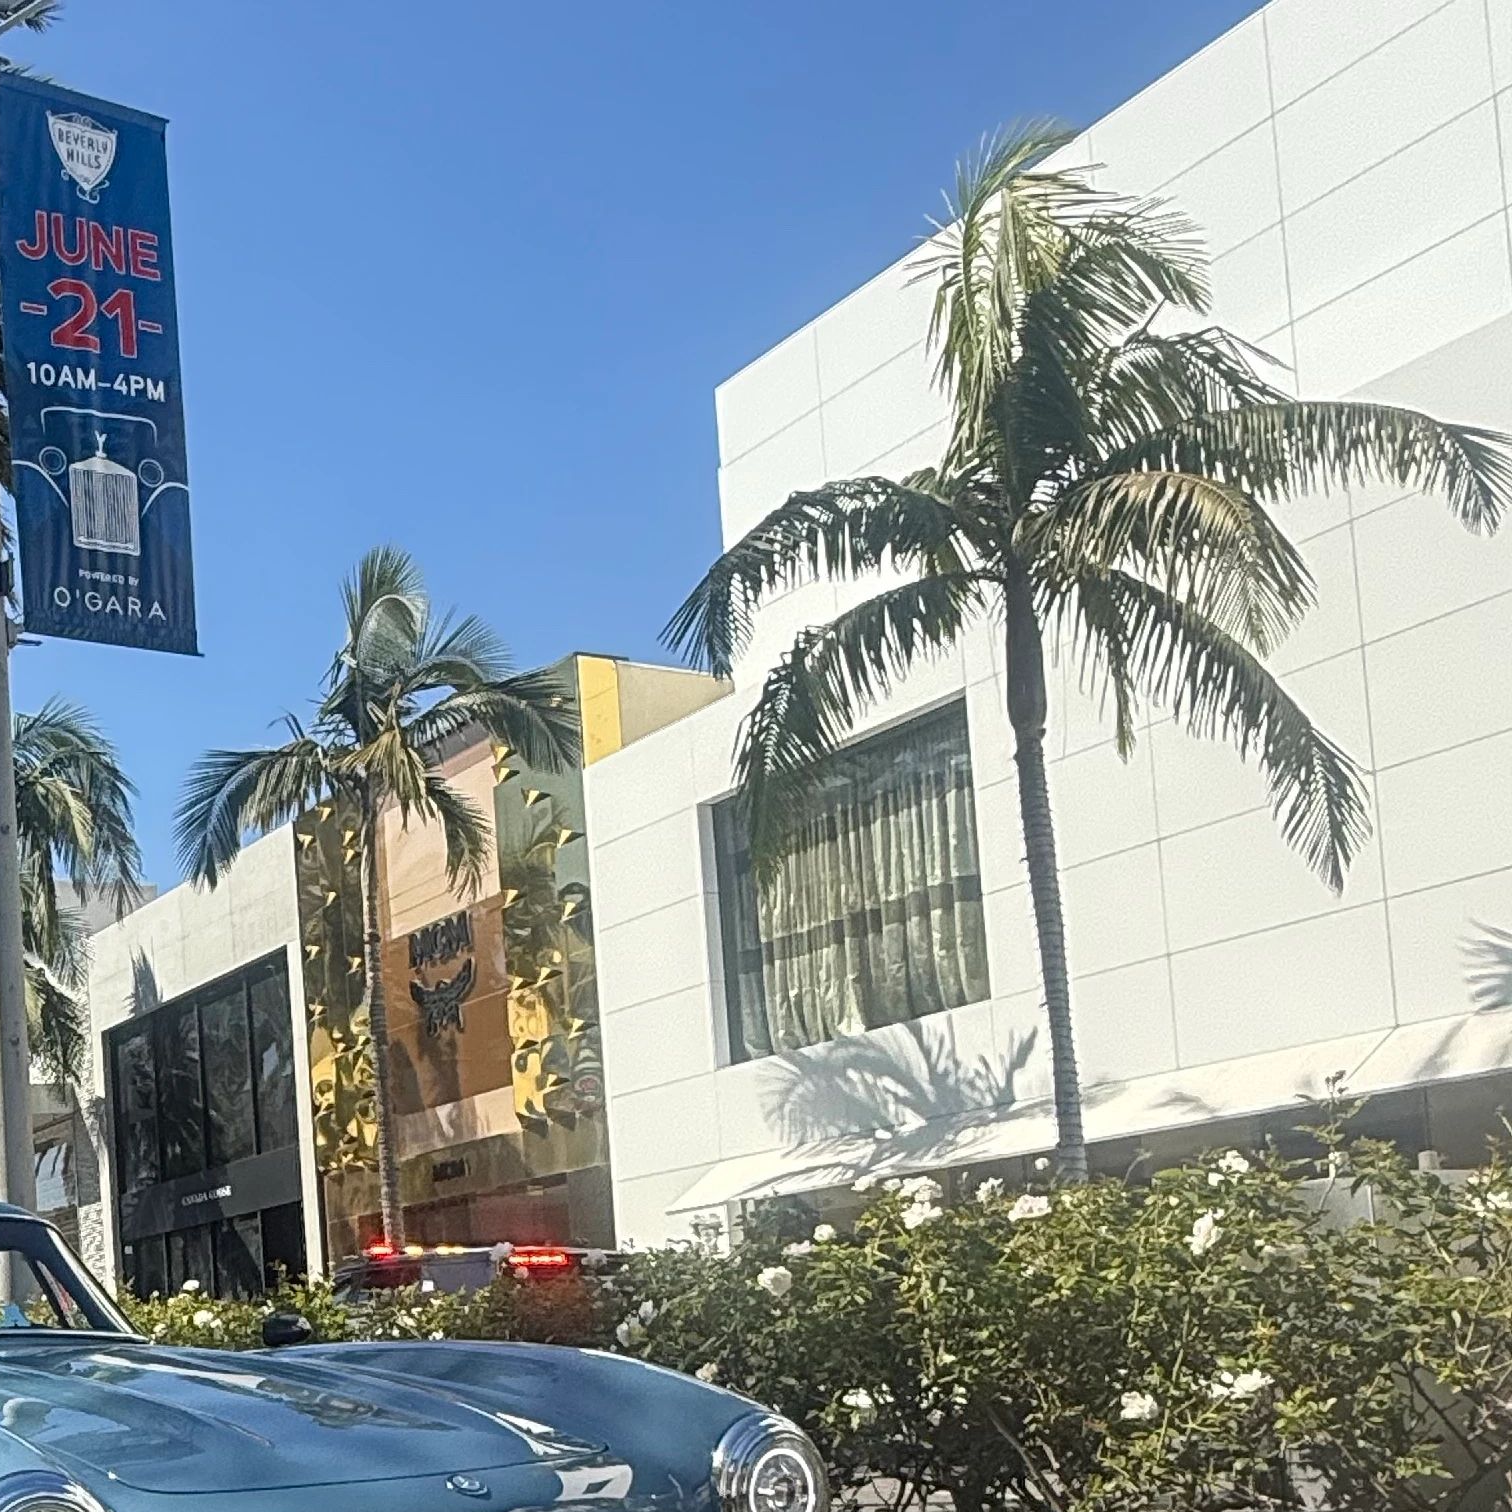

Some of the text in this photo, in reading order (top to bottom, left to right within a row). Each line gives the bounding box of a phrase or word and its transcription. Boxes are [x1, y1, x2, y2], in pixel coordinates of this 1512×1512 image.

[58, 127, 108, 154] BEVERLY
[66, 147, 102, 169] HILLS
[16, 210, 161, 282] JUNE
[53, 585, 167, 621] O'GARA
